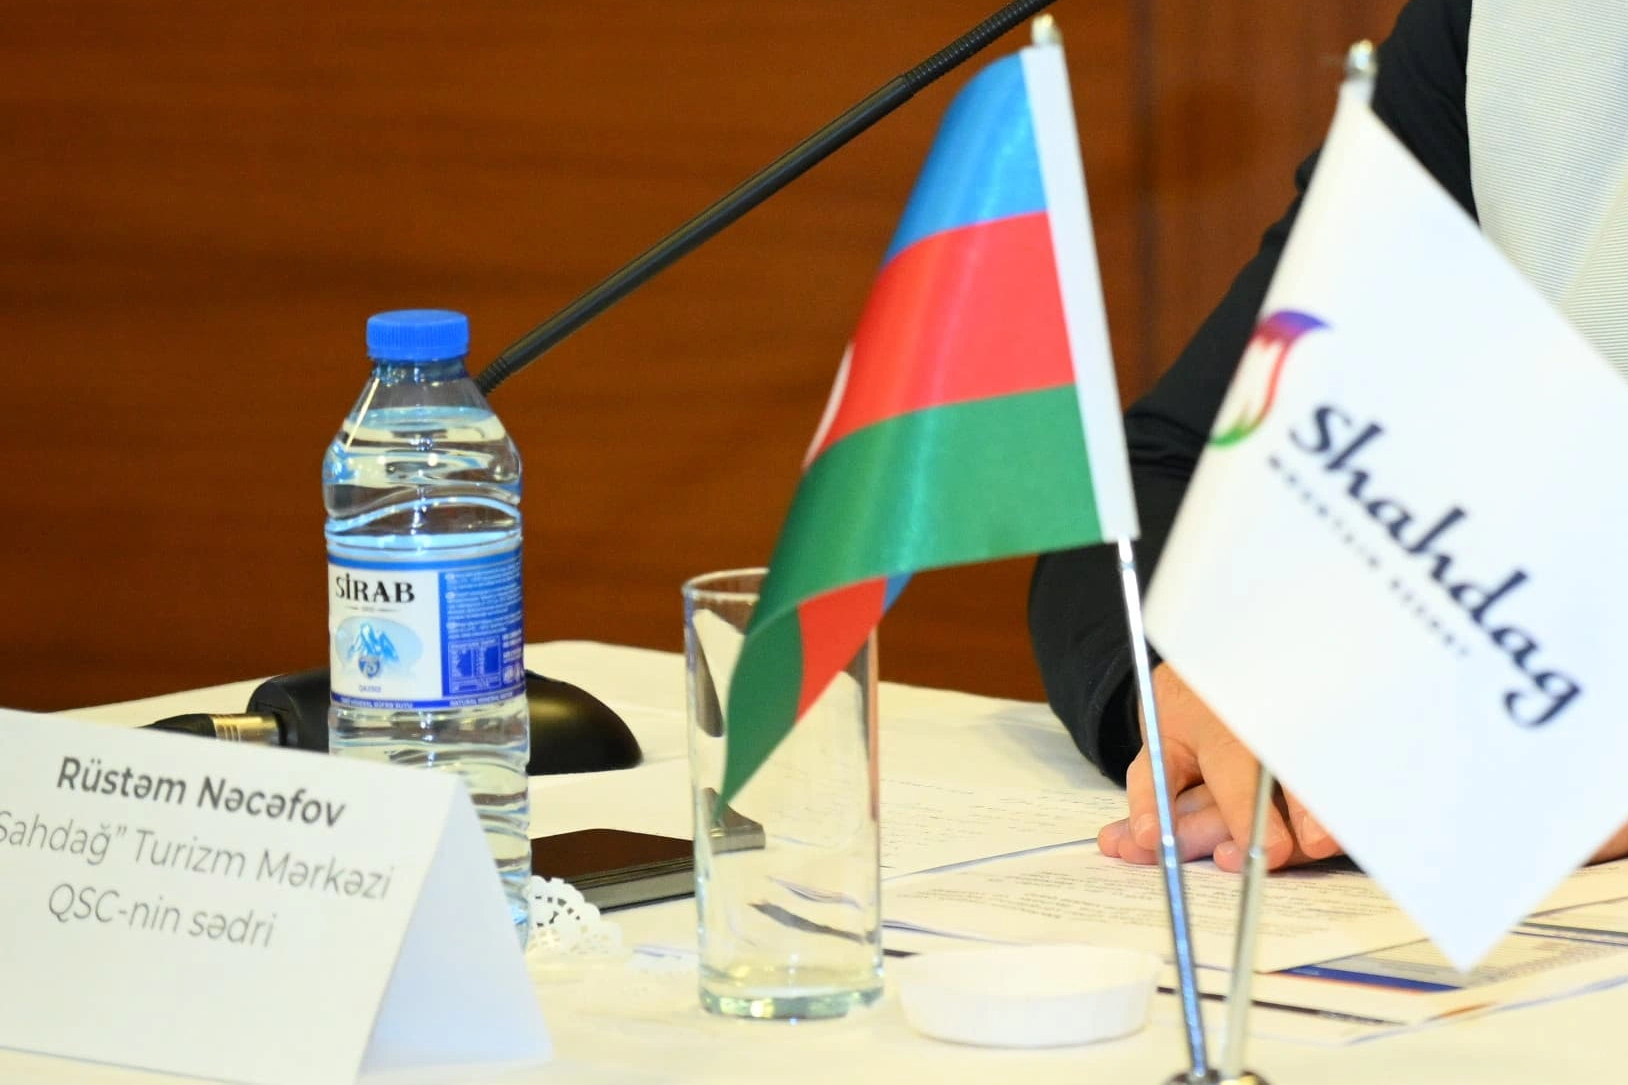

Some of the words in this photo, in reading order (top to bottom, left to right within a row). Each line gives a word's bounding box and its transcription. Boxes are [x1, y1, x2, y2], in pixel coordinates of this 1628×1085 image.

[336, 573, 416, 603] SİRAB
[1287, 404, 1583, 728] Shahdag
[56, 756, 187, 807] Rüstəm
[196, 775, 347, 829] Nəcəfov
[134, 829, 247, 879] Turizm
[257, 850, 395, 900] Mərkəzi
[48, 882, 180, 935] QSC-nin
[188, 908, 279, 949] sədri
